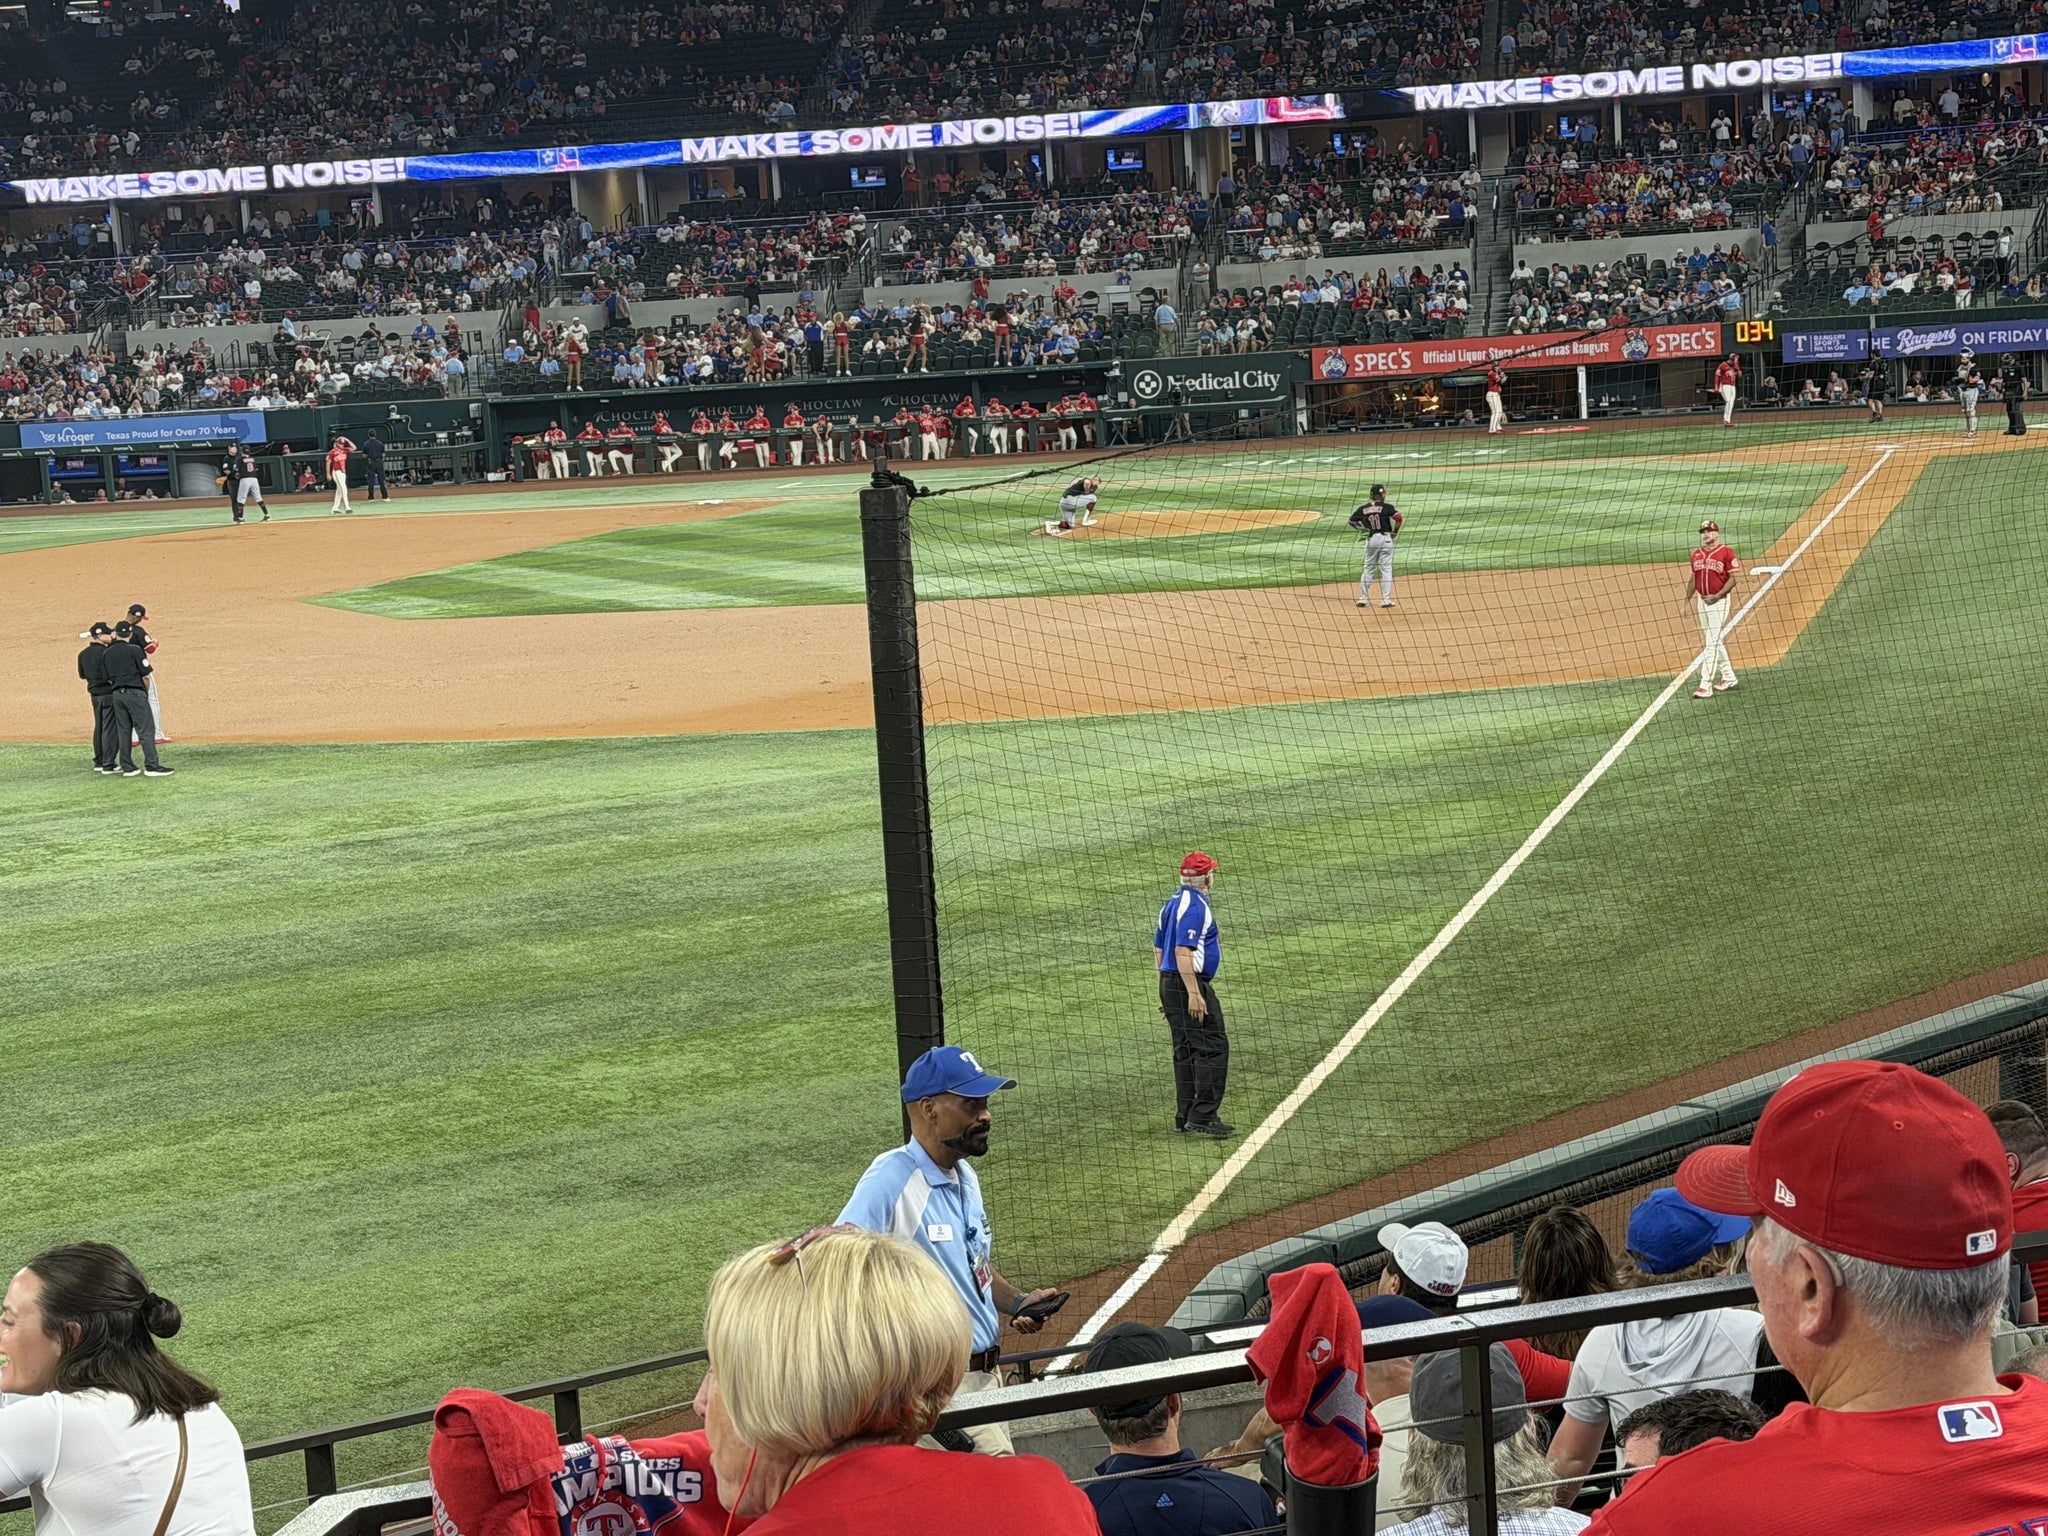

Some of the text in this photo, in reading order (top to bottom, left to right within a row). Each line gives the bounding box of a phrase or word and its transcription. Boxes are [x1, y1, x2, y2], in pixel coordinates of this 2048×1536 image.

[1414, 53, 1844, 111] MAKE SOME NOISE!
[681, 112, 1082, 163] MAKE SOME NOISE!
[25, 157, 408, 204] MAKE SOME NOISE!
[1655, 327, 1716, 352] SPEC'S
[1736, 319, 1774, 343] 034
[1792, 333, 1846, 352] T RANGERS
[1857, 336, 1891, 352] THE
[1896, 328, 1958, 355] Rangers
[1962, 332, 1985, 345] ON
[1988, 328, 2042, 344] FRIDAY
[1422, 349, 1457, 364] Official
[1458, 347, 1487, 364] Liquor
[1488, 346, 1514, 360] Store
[1543, 343, 1571, 356] Texas
[1572, 341, 1610, 356] Rangers
[1813, 339, 1841, 347] SPORTS
[1354, 347, 1412, 372] SPEC'S
[1242, 370, 1282, 392] City
[887, 393, 961, 406] CHOCTAW
[57, 426, 237, 446] Kroger Texas Proud for Over 70 Years
[1368, 514, 1381, 530] 11
[1187, 929, 1197, 940] T
[959, 1051, 984, 1074] T
[571, 1495, 639, 1524] TEXAS
